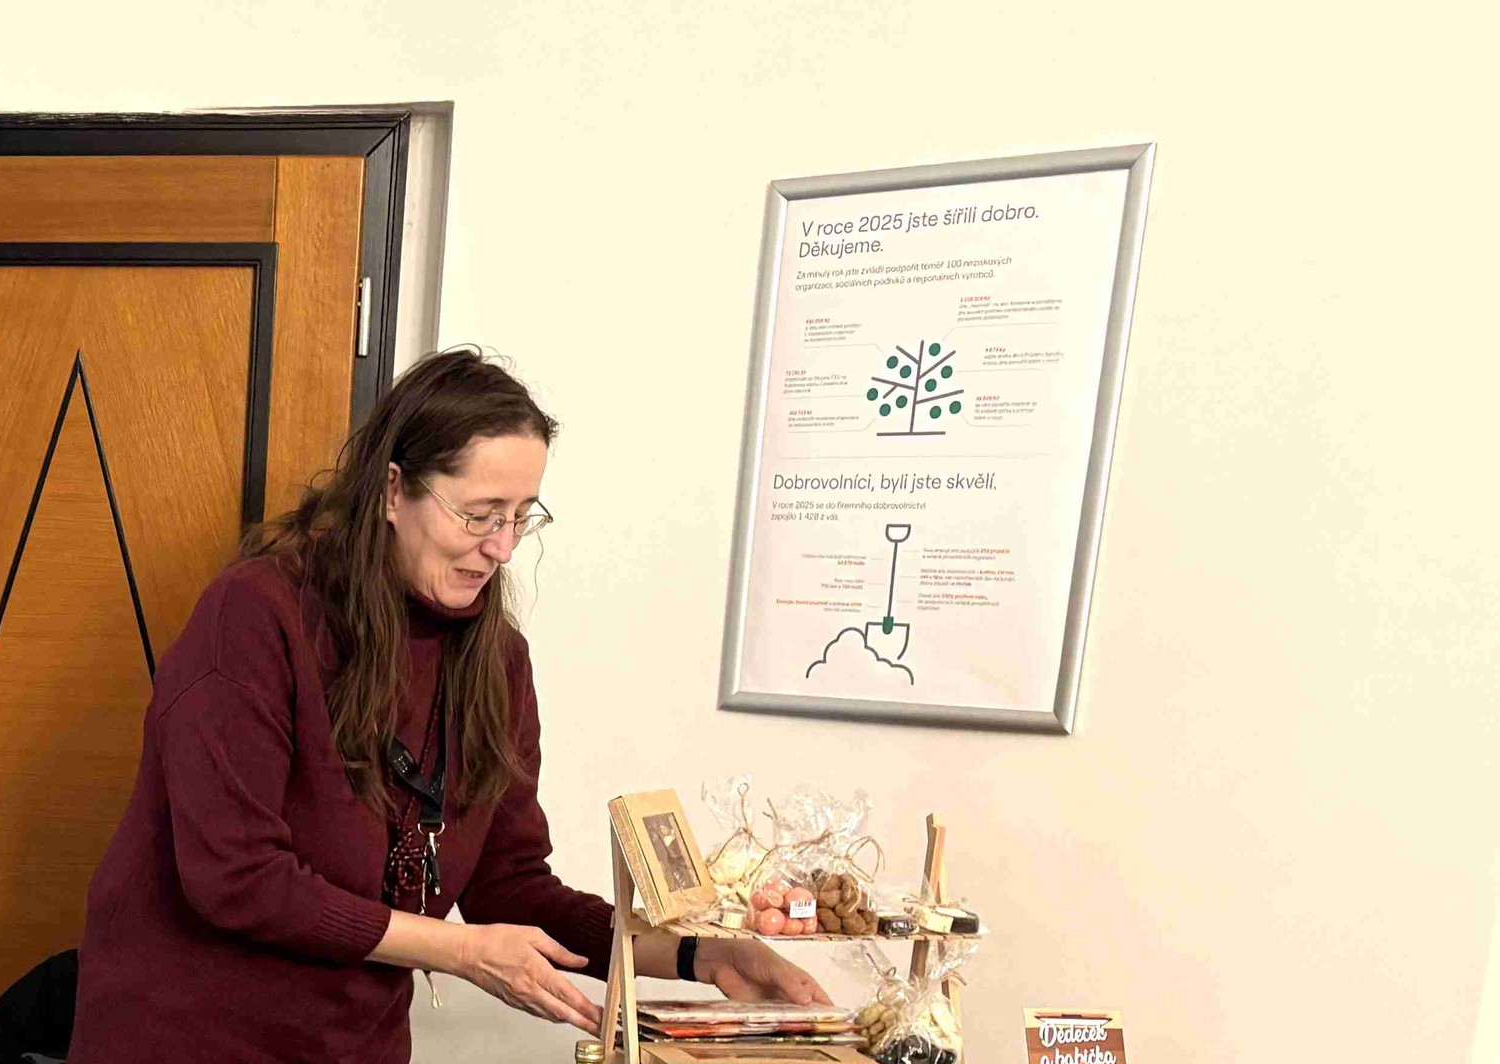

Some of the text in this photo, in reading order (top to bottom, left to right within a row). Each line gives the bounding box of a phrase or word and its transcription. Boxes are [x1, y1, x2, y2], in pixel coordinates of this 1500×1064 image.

[802, 203, 1040, 238] V roce 2025 jste šířili dobro.
[798, 239, 884, 259] Děkujeme.
[946, 259, 962, 269] 100
[773, 472, 997, 493] Dobrovolníci, byli jste skvělí.
[815, 502, 824, 510] se
[825, 501, 836, 510] do
